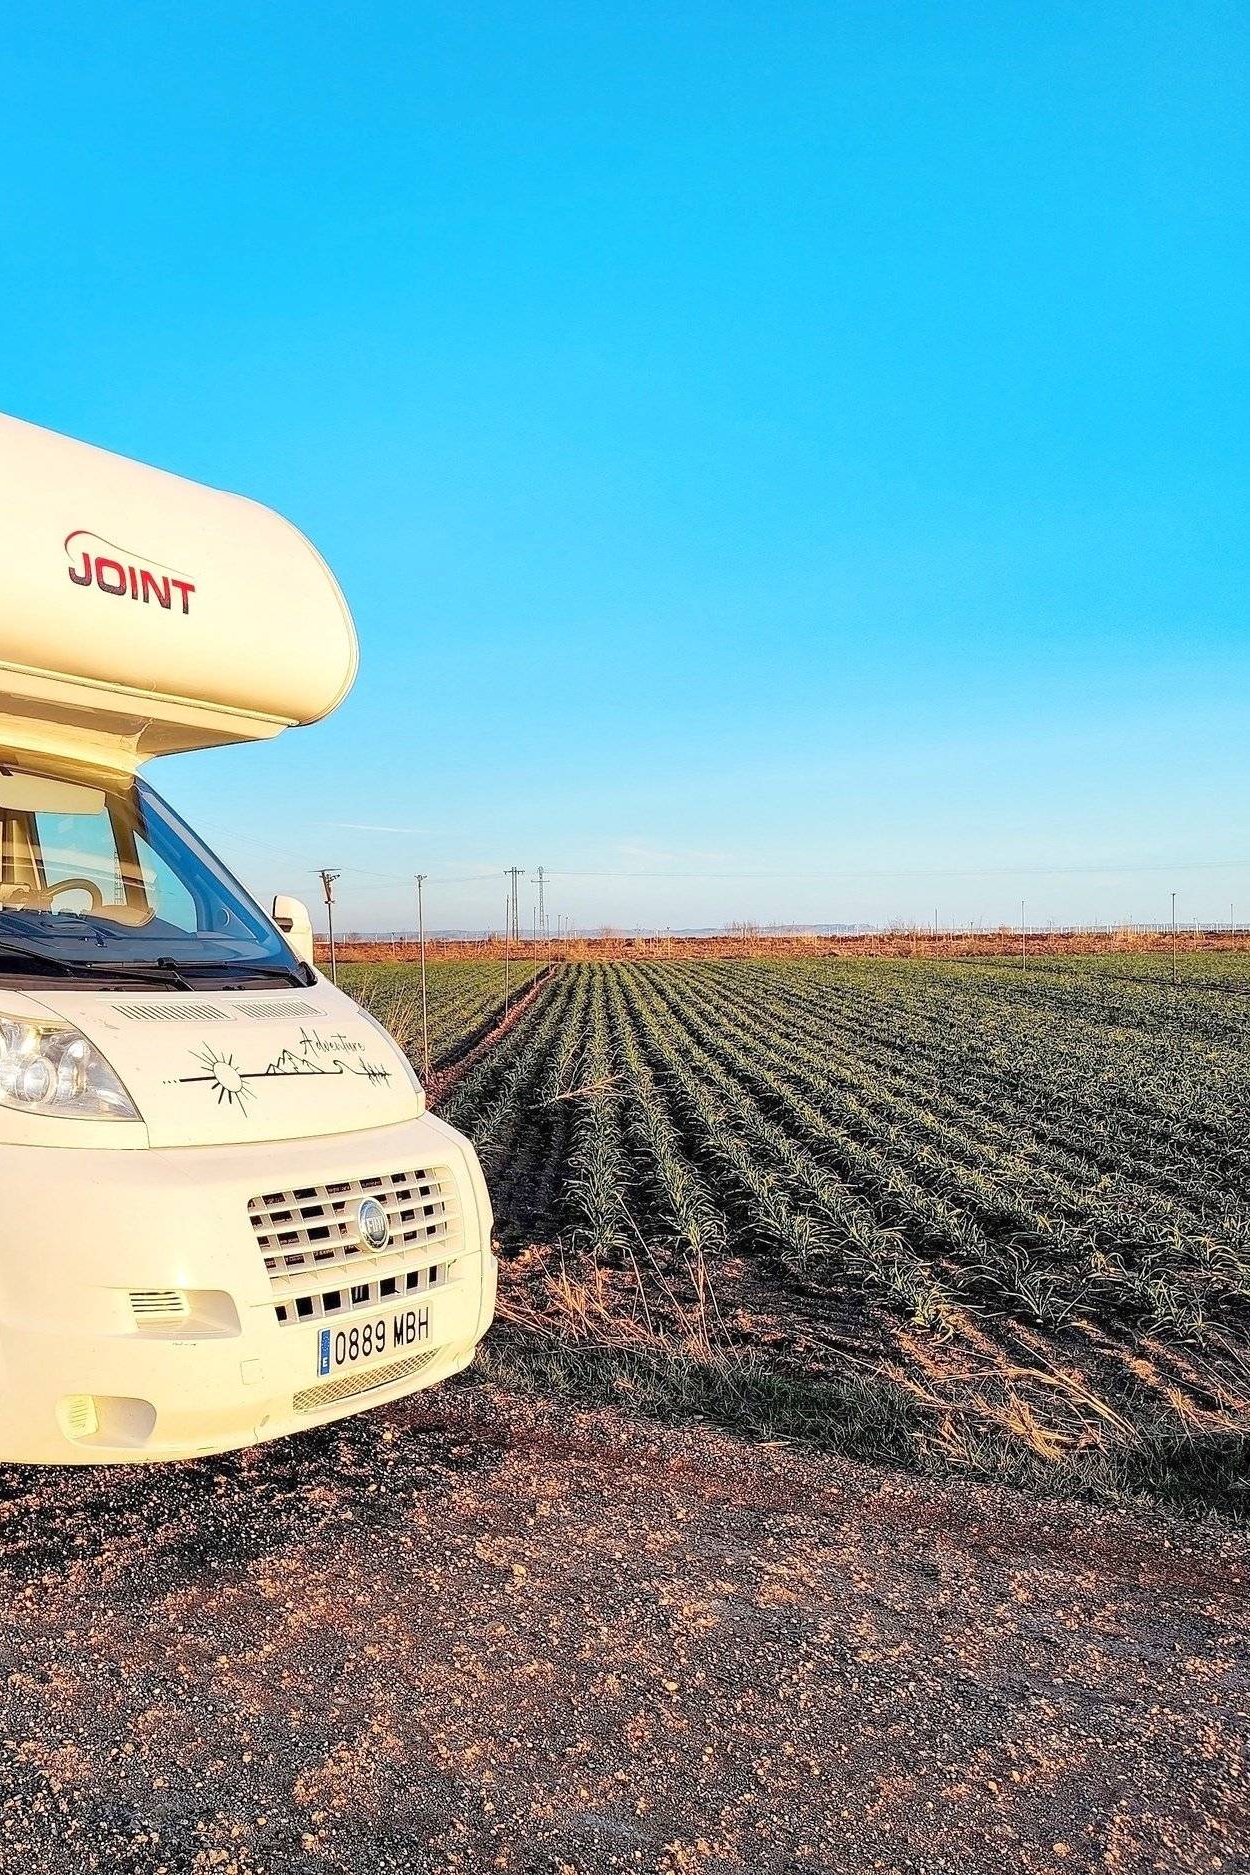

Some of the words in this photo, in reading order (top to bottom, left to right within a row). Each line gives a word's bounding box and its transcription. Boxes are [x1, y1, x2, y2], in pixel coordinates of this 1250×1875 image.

[68, 552, 196, 615] JOINT
[299, 1026, 366, 1059] Adventure
[335, 1320, 386, 1365] 0889
[393, 1306, 429, 1348] MBH
[322, 1357, 328, 1367] E
